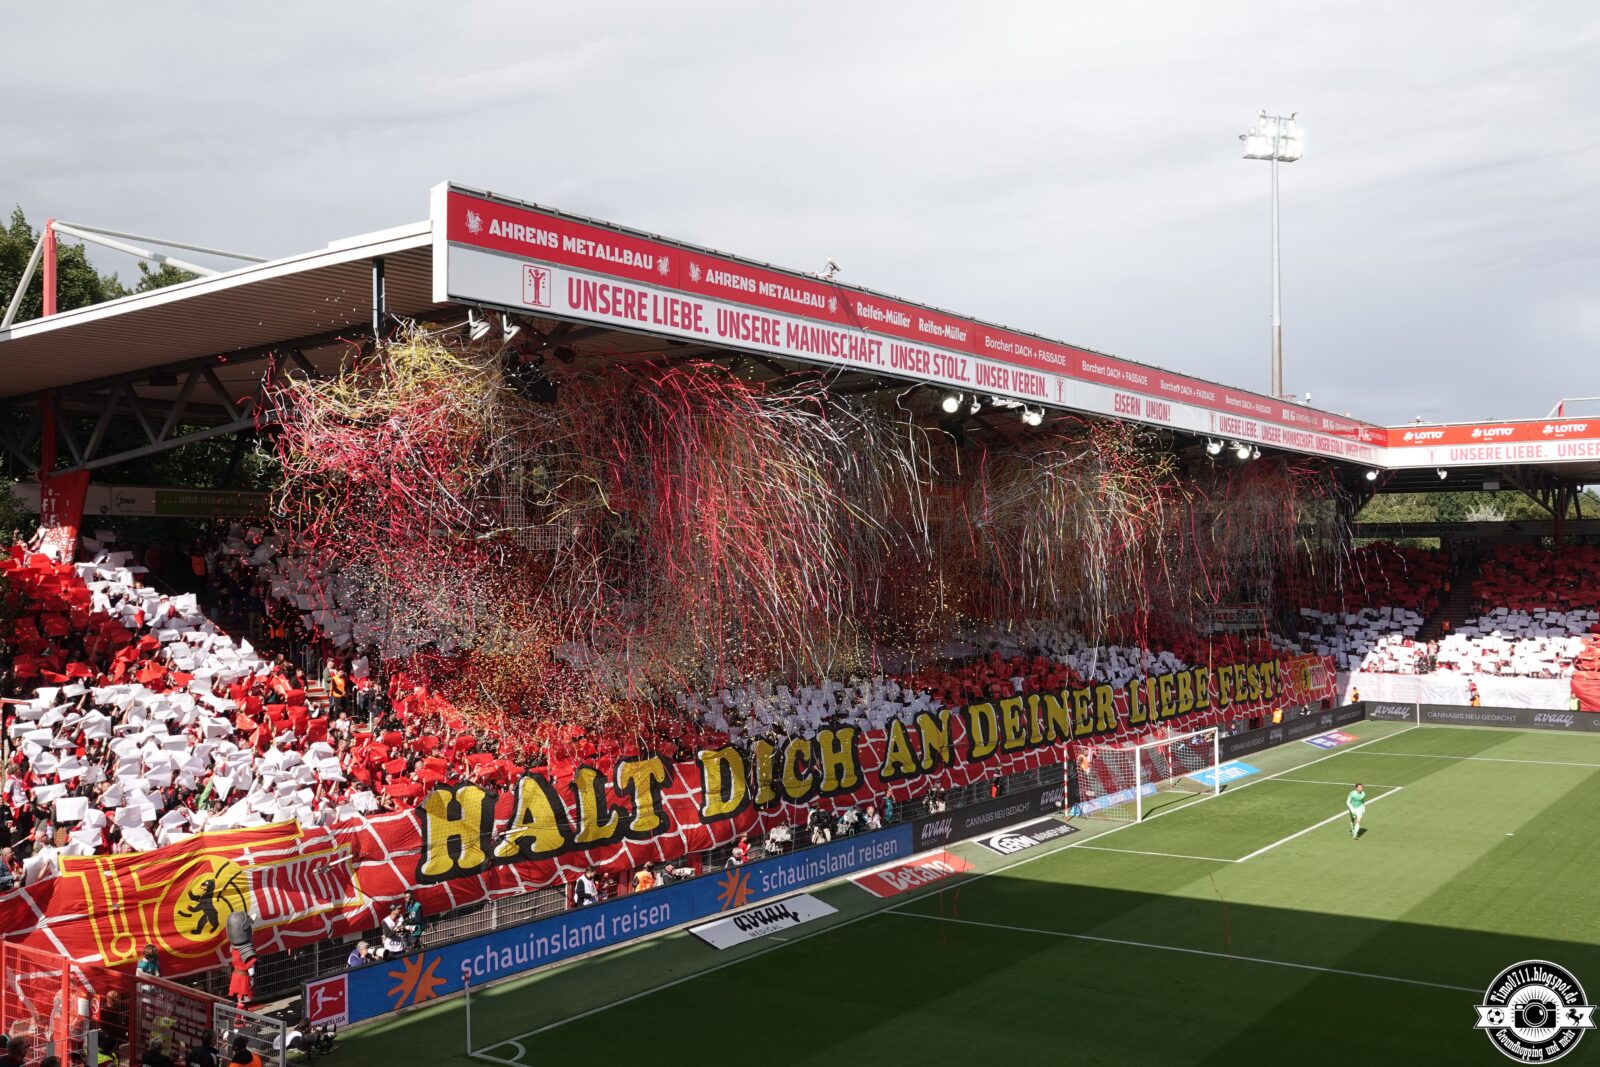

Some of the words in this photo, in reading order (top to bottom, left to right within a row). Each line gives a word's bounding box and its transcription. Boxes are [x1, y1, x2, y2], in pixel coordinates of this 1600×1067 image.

[489, 219, 559, 249] AHRENS
[562, 235, 653, 270] METALLBAU
[706, 269, 756, 293] AHRENS
[759, 282, 825, 309] METALLBAU
[856, 302, 912, 329] Reifen-Müller
[568, 277, 648, 326] UNSERE
[653, 298, 709, 334] LIEBE.
[717, 308, 781, 346] UNSERE
[786, 323, 885, 366] MANNSCHAFT.
[890, 343, 930, 375] UNSER
[933, 353, 970, 383] STOLZ.
[976, 363, 1009, 390] UNSER
[1012, 371, 1048, 398] VEREIN.
[919, 318, 968, 342] Reifen-Müller
[985, 336, 1014, 353] Borchert
[1014, 343, 1032, 358] DACH
[1039, 349, 1066, 366] FASSADE
[1082, 361, 1105, 375] Borchert
[1106, 367, 1121, 379] DACH
[1126, 371, 1148, 385] FASSADE
[1115, 393, 1141, 417] EISERN
[1146, 400, 1170, 422] UNION!
[1219, 416, 1241, 435] UNSERE
[1242, 420, 1258, 438] LIEBE.
[1262, 425, 1280, 442] UNSERE
[1415, 430, 1444, 440] LOTTO
[1483, 427, 1515, 436] LOTTO
[1555, 423, 1588, 433] LOTTO
[1450, 446, 1501, 461] UNSERE
[1505, 444, 1548, 459] LIEBE.
[1375, 706, 1410, 719] avaay
[1427, 711, 1464, 720] CANNABIS
[1465, 712, 1480, 720] NEU
[1481, 714, 1517, 723] GEDACHT
[1534, 713, 1573, 727] avaay
[418, 752, 671, 882] HALT
[699, 725, 862, 820] DICH
[880, 710, 951, 779] AN
[967, 684, 1118, 760] DEINER
[1129, 667, 1210, 726] LIEBE
[1217, 659, 1281, 707] FEST!
[921, 817, 952, 839] avaay
[965, 813, 994, 828] CANNABIS
[994, 808, 1004, 820] NEU
[1005, 802, 1030, 817] GEDACHT
[762, 846, 856, 892] schauinsland
[859, 837, 898, 863] reisen
[878, 861, 955, 890] Betano
[252, 849, 358, 921] UNION
[733, 903, 800, 932] avaay
[460, 913, 605, 979] schauinsland
[612, 899, 671, 934] reisen
